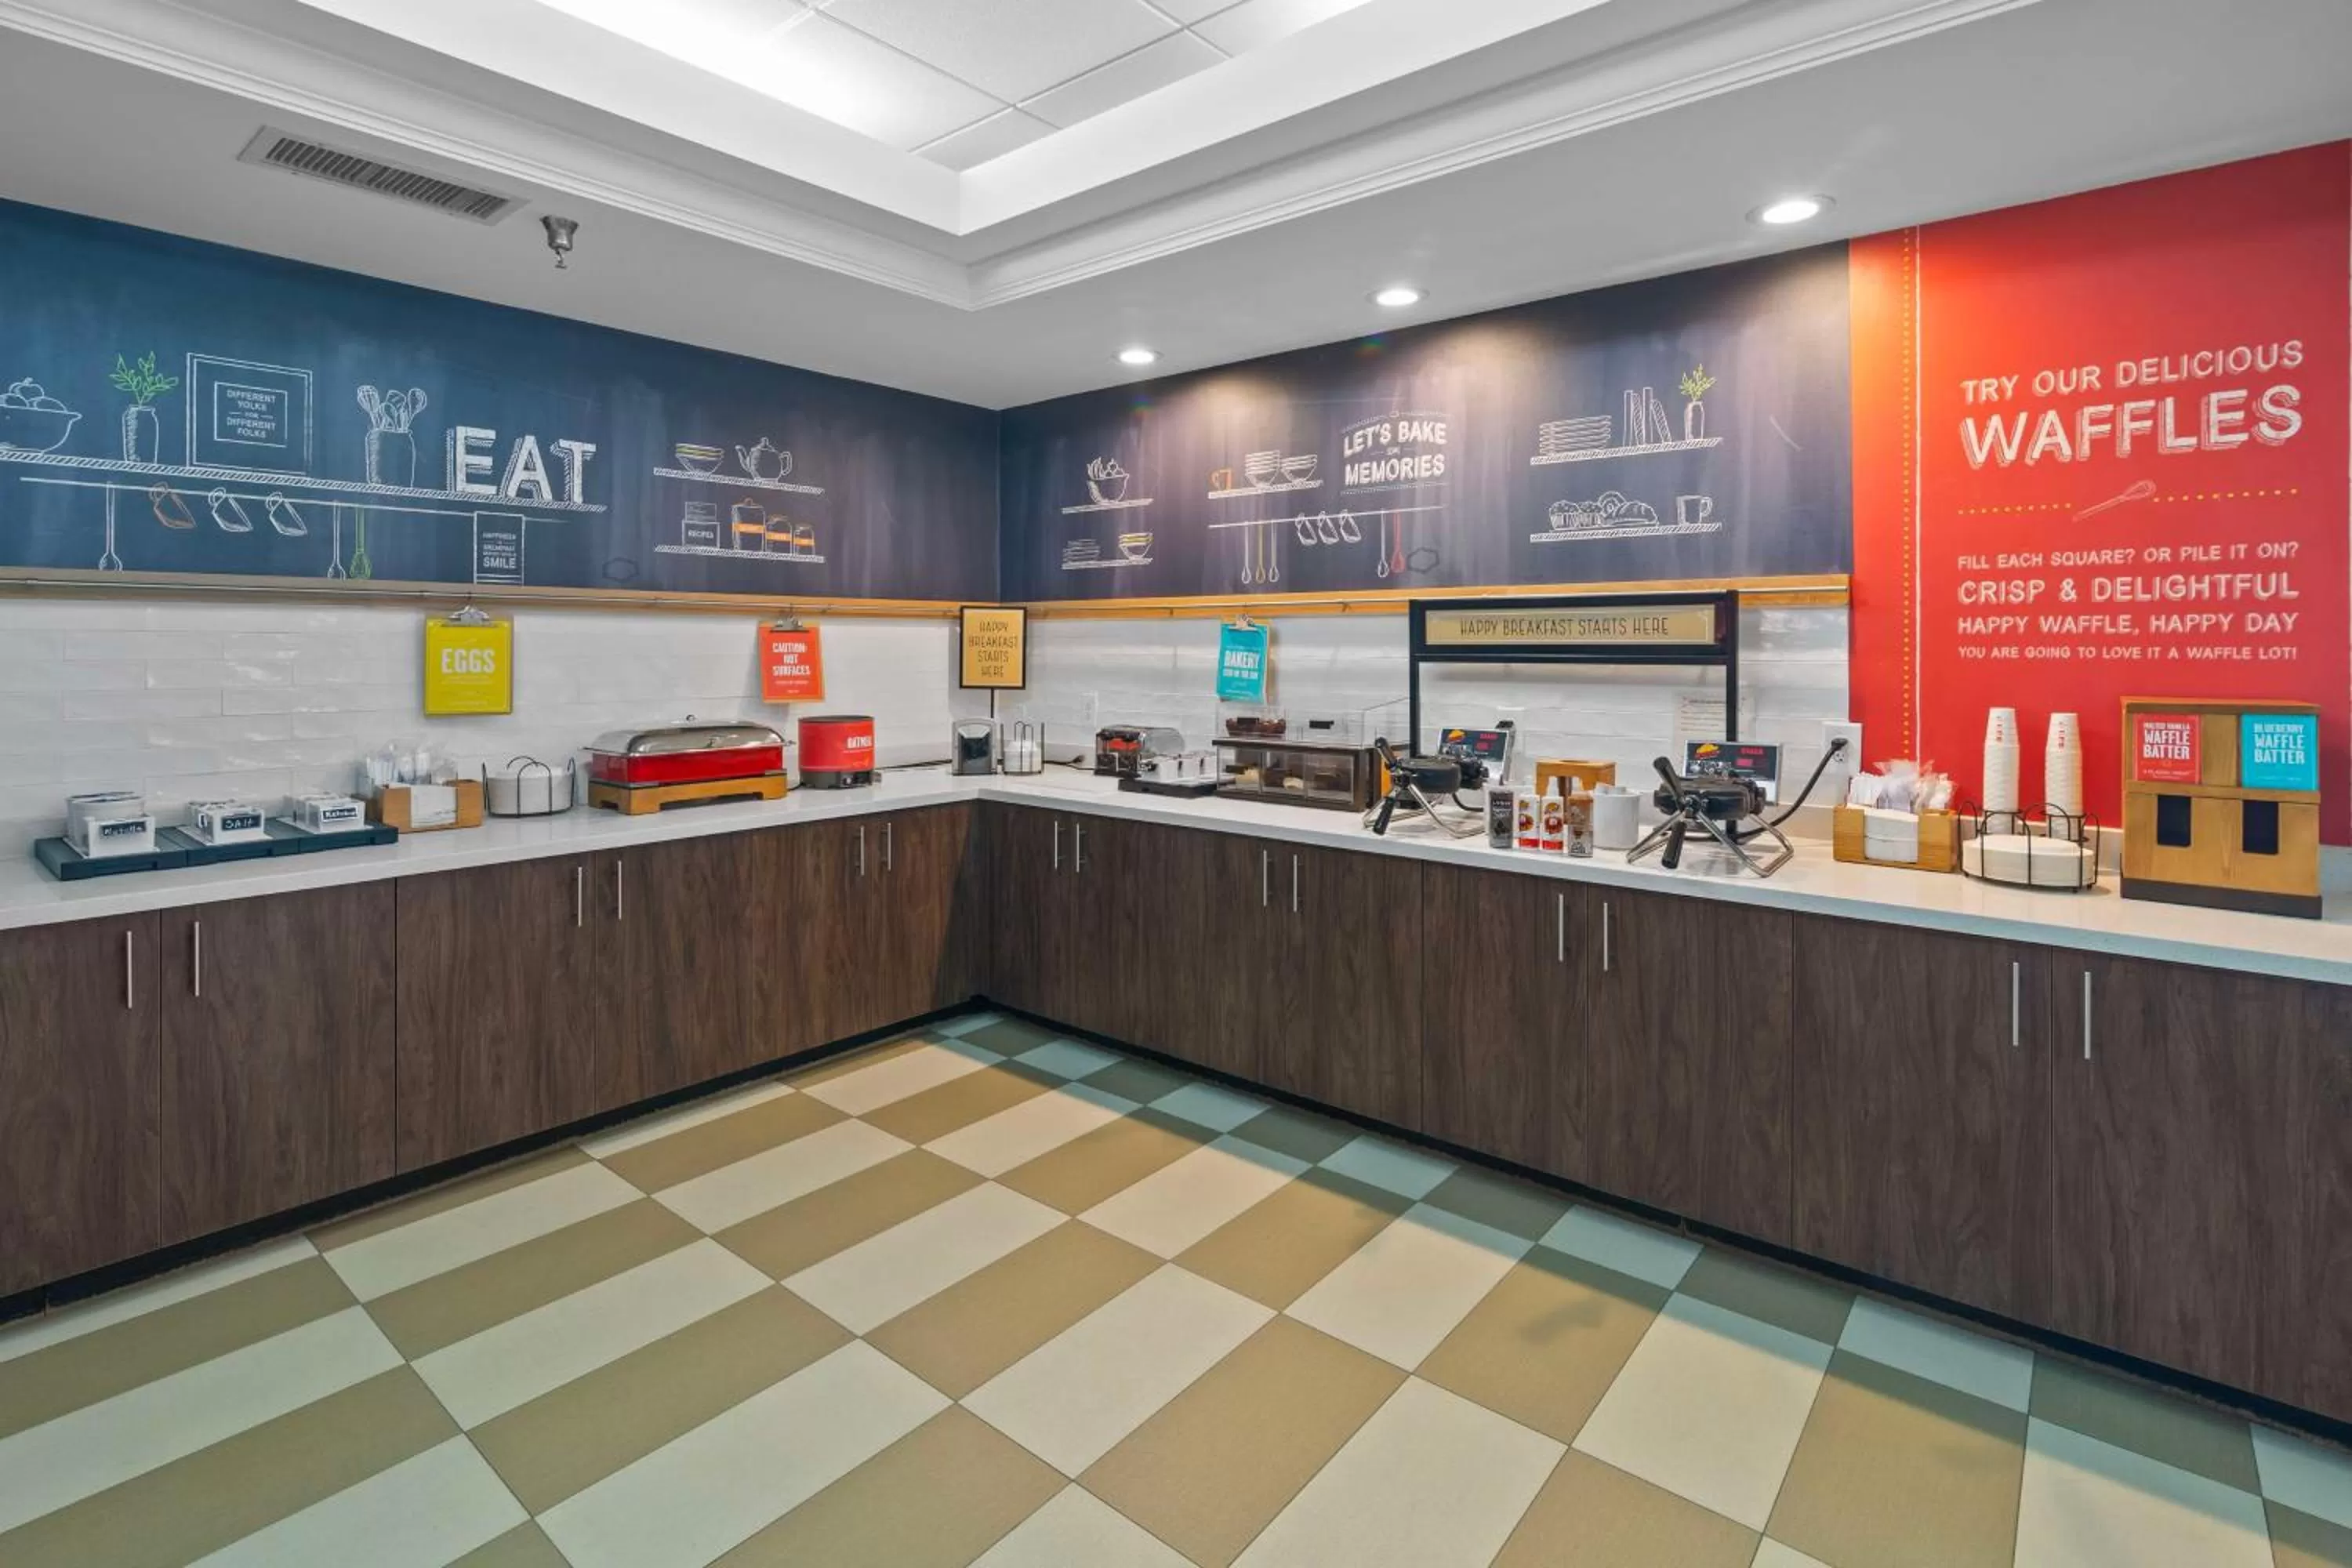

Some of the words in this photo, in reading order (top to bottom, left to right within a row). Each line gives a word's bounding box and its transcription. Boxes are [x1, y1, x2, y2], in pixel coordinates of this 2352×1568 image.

[1961, 375, 2019, 405] TRY
[2032, 365, 2102, 397] OUR
[2116, 339, 2303, 388] DELICIOUS
[227, 389, 276, 402] DIFFERENT
[227, 417, 276, 430] DIFFERENT
[1960, 383, 2303, 470] WAFFLES
[238, 428, 267, 438] FOLKS
[1344, 423, 1392, 458] LET'S
[1398, 420, 1448, 445] BAKE
[446, 426, 596, 503] EAT
[1345, 453, 1446, 486] MEMORIES
[483, 556, 517, 568] SMILE
[1958, 555, 1990, 569] FILL
[1997, 553, 2043, 568] EACH
[2050, 548, 2136, 567] SQUARE?
[2143, 547, 2172, 563] OR
[2180, 545, 2221, 561] PILE
[2230, 543, 2248, 559] IT
[2256, 541, 2299, 558] ON?
[1958, 579, 2046, 605] CRISP
[2059, 578, 2078, 603] &
[2091, 572, 2300, 603] DELIGHTFUL
[978, 620, 1009, 633] HAPPY
[1460, 619, 1498, 637] HAPPY
[1503, 619, 1573, 636] BREAKFAST
[1578, 618, 1628, 636] STARTS
[1633, 616, 1668, 636] HERE
[1958, 615, 2030, 634] HAPPY
[2039, 614, 2140, 636] WAFFLE,
[2150, 614, 2234, 633] HAPPY
[2245, 612, 2299, 633] DAY
[968, 635, 1018, 648] BREAKFAST
[783, 653, 798, 665] HOT
[978, 650, 1010, 662] STARTS
[1224, 650, 1261, 669] BAKERY
[1958, 646, 1986, 659] YOU
[1991, 646, 2020, 659] ARE
[2025, 646, 2071, 659] GOING
[2078, 647, 2096, 659] TO
[2103, 646, 2142, 659] LOVE
[2147, 646, 2161, 659] IT
[2168, 647, 2180, 659] A
[2187, 646, 2252, 659] WAFFLE
[2258, 647, 2297, 659] LOT!
[441, 648, 495, 674] EGGS
[772, 664, 811, 677] SURFACES
[981, 665, 1004, 677] HERE
[2143, 729, 2190, 746] WAFFLE
[2254, 733, 2306, 749] WAFFLE
[2143, 744, 2190, 760] BATTER
[2253, 749, 2305, 764] BATTER
